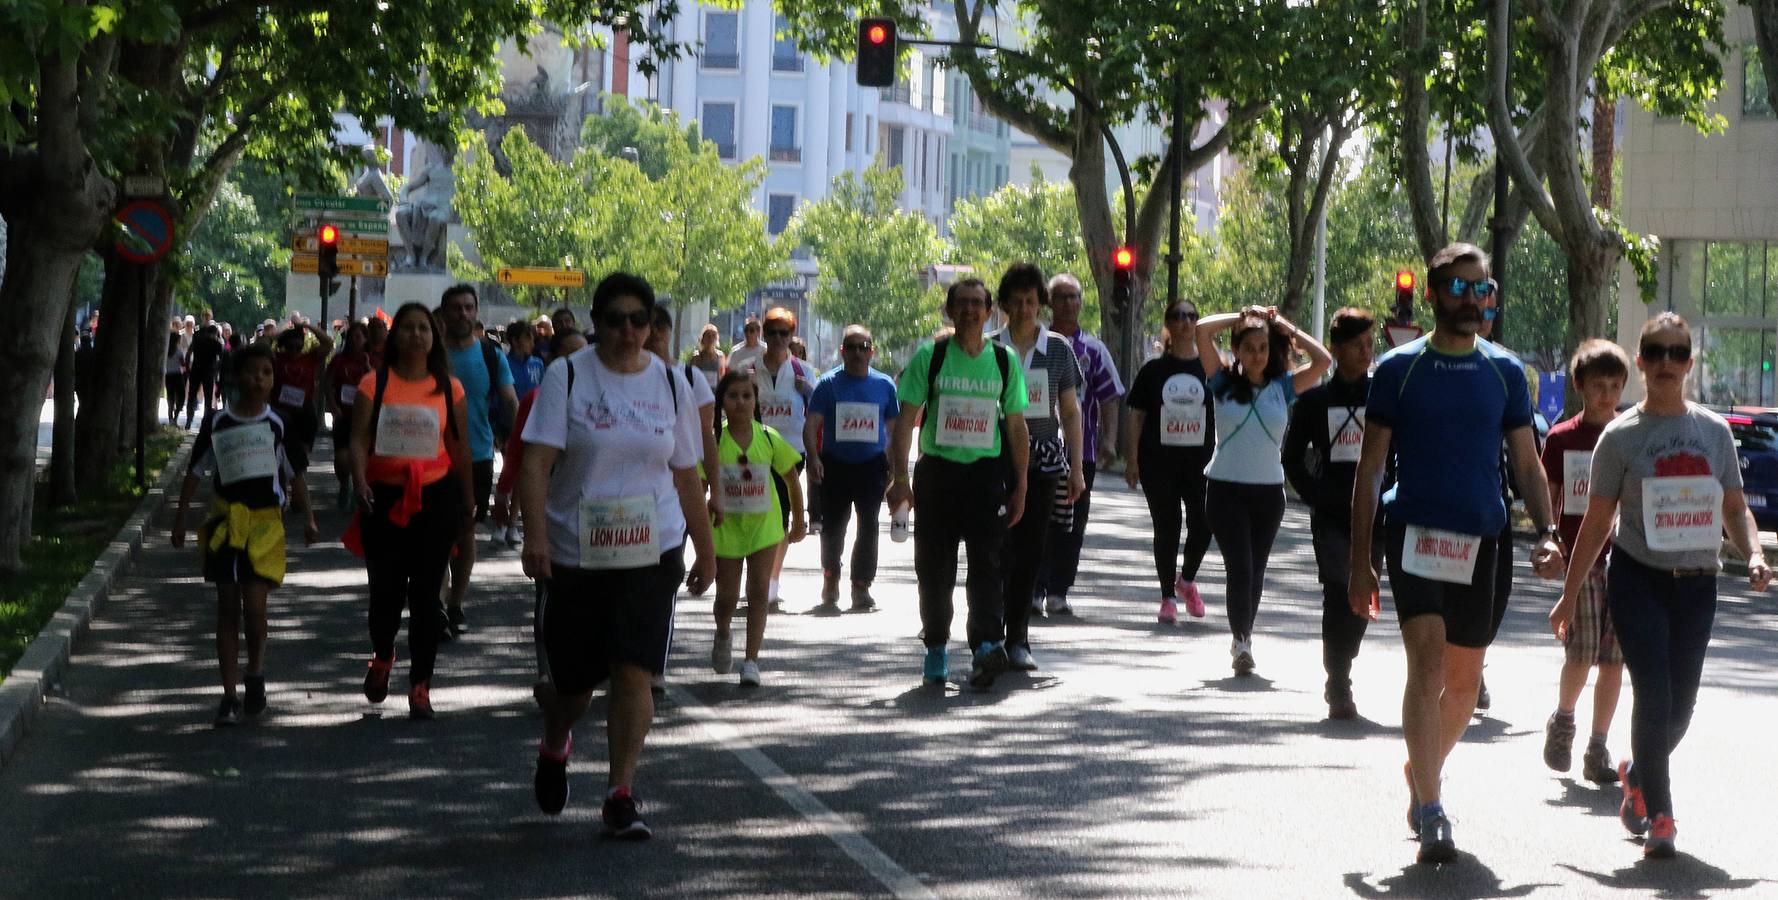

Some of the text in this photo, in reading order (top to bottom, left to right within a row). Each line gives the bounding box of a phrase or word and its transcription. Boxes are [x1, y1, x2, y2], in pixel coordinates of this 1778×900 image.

[936, 376, 1003, 394] HERBALIF
[760, 405, 791, 416] ZAPA
[843, 418, 874, 430] ZAPA
[1167, 421, 1200, 433] CALVO
[614, 525, 650, 547] SALAZAR
